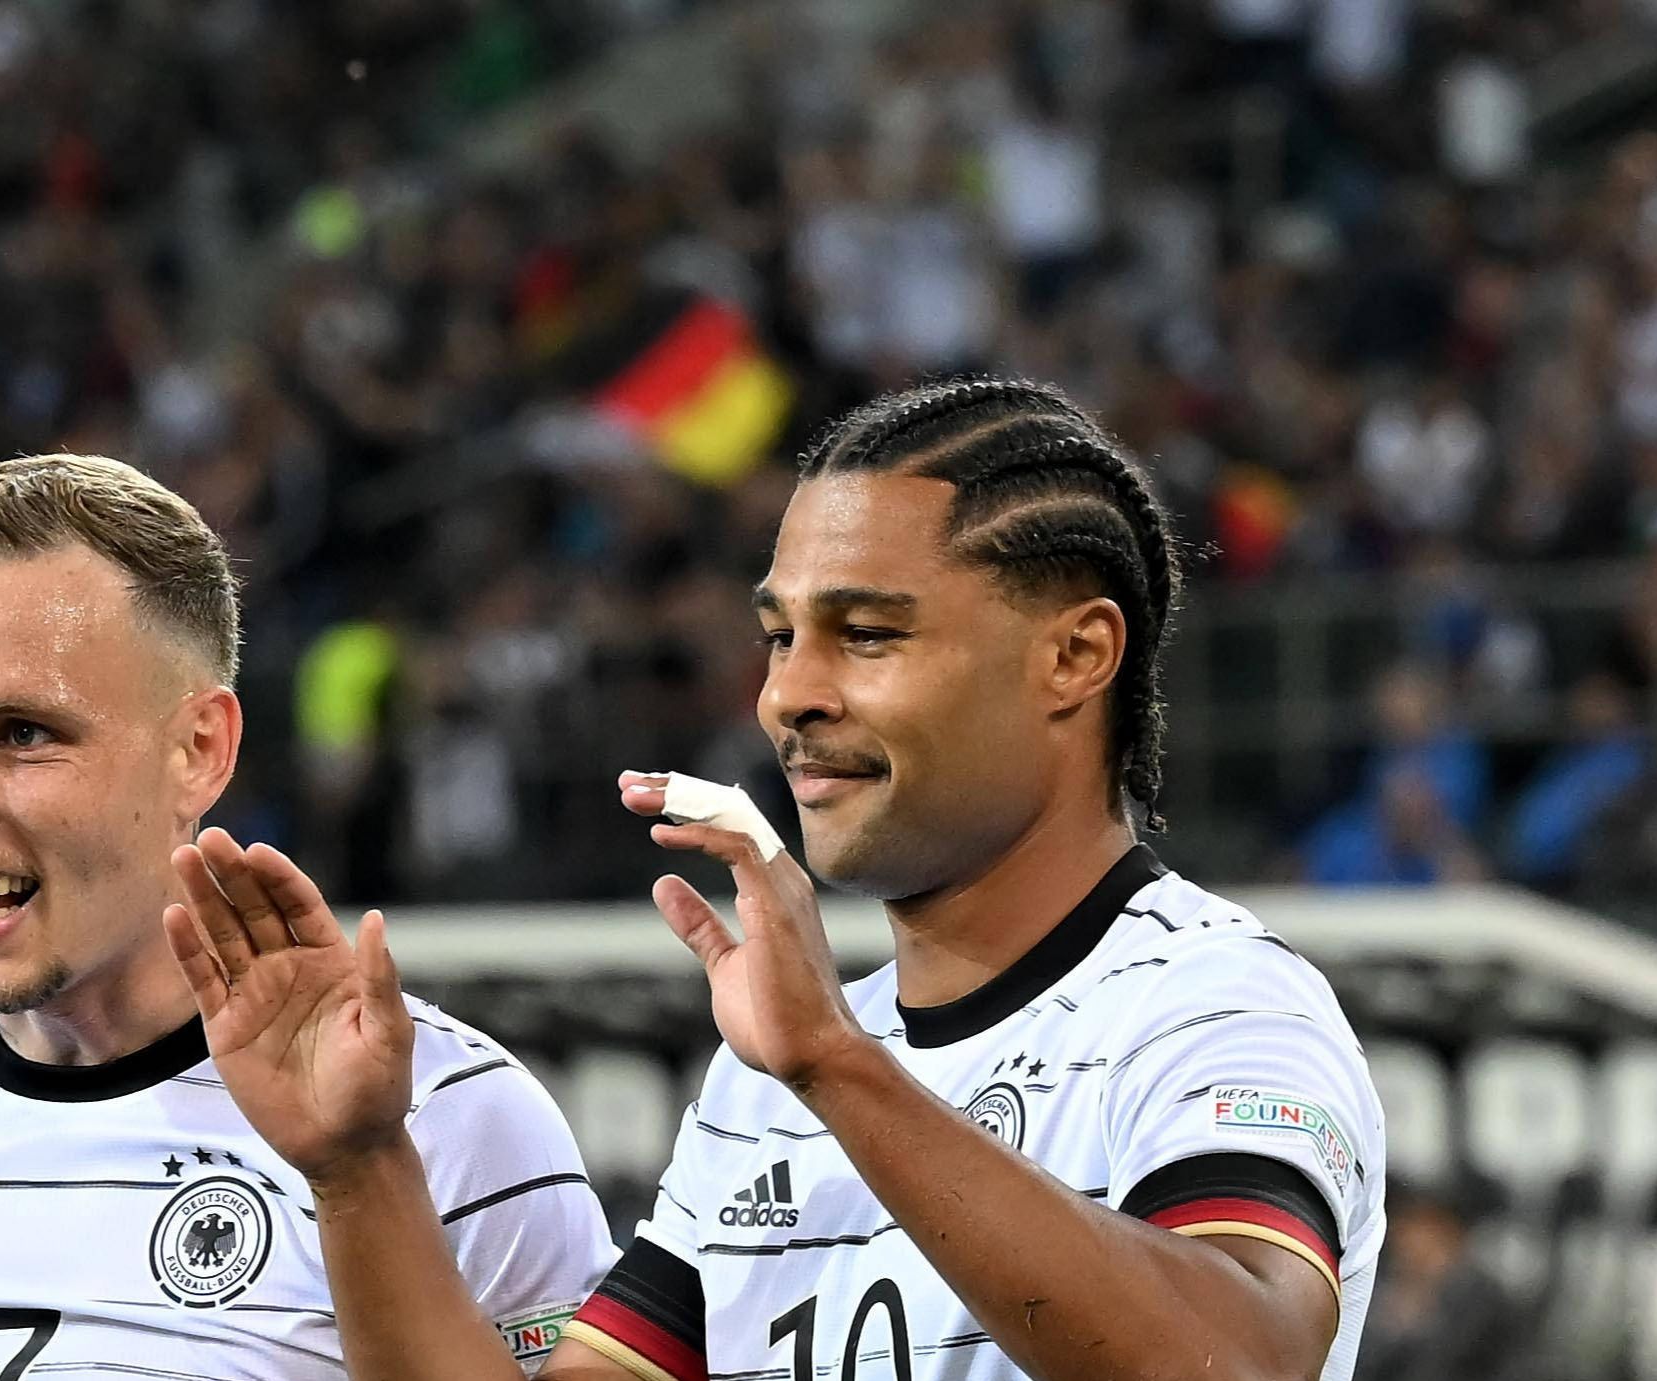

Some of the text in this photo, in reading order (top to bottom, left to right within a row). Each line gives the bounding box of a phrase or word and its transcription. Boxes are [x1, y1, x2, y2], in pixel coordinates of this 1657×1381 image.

[1215, 1088, 1260, 1100] UEFA
[1215, 1102, 1352, 1183] FOUNDATION
[181, 1193, 250, 1218] DEUTSCHER
[719, 1201, 799, 1227] adidas
[166, 1255, 248, 1291] FUSSBALL-BUND
